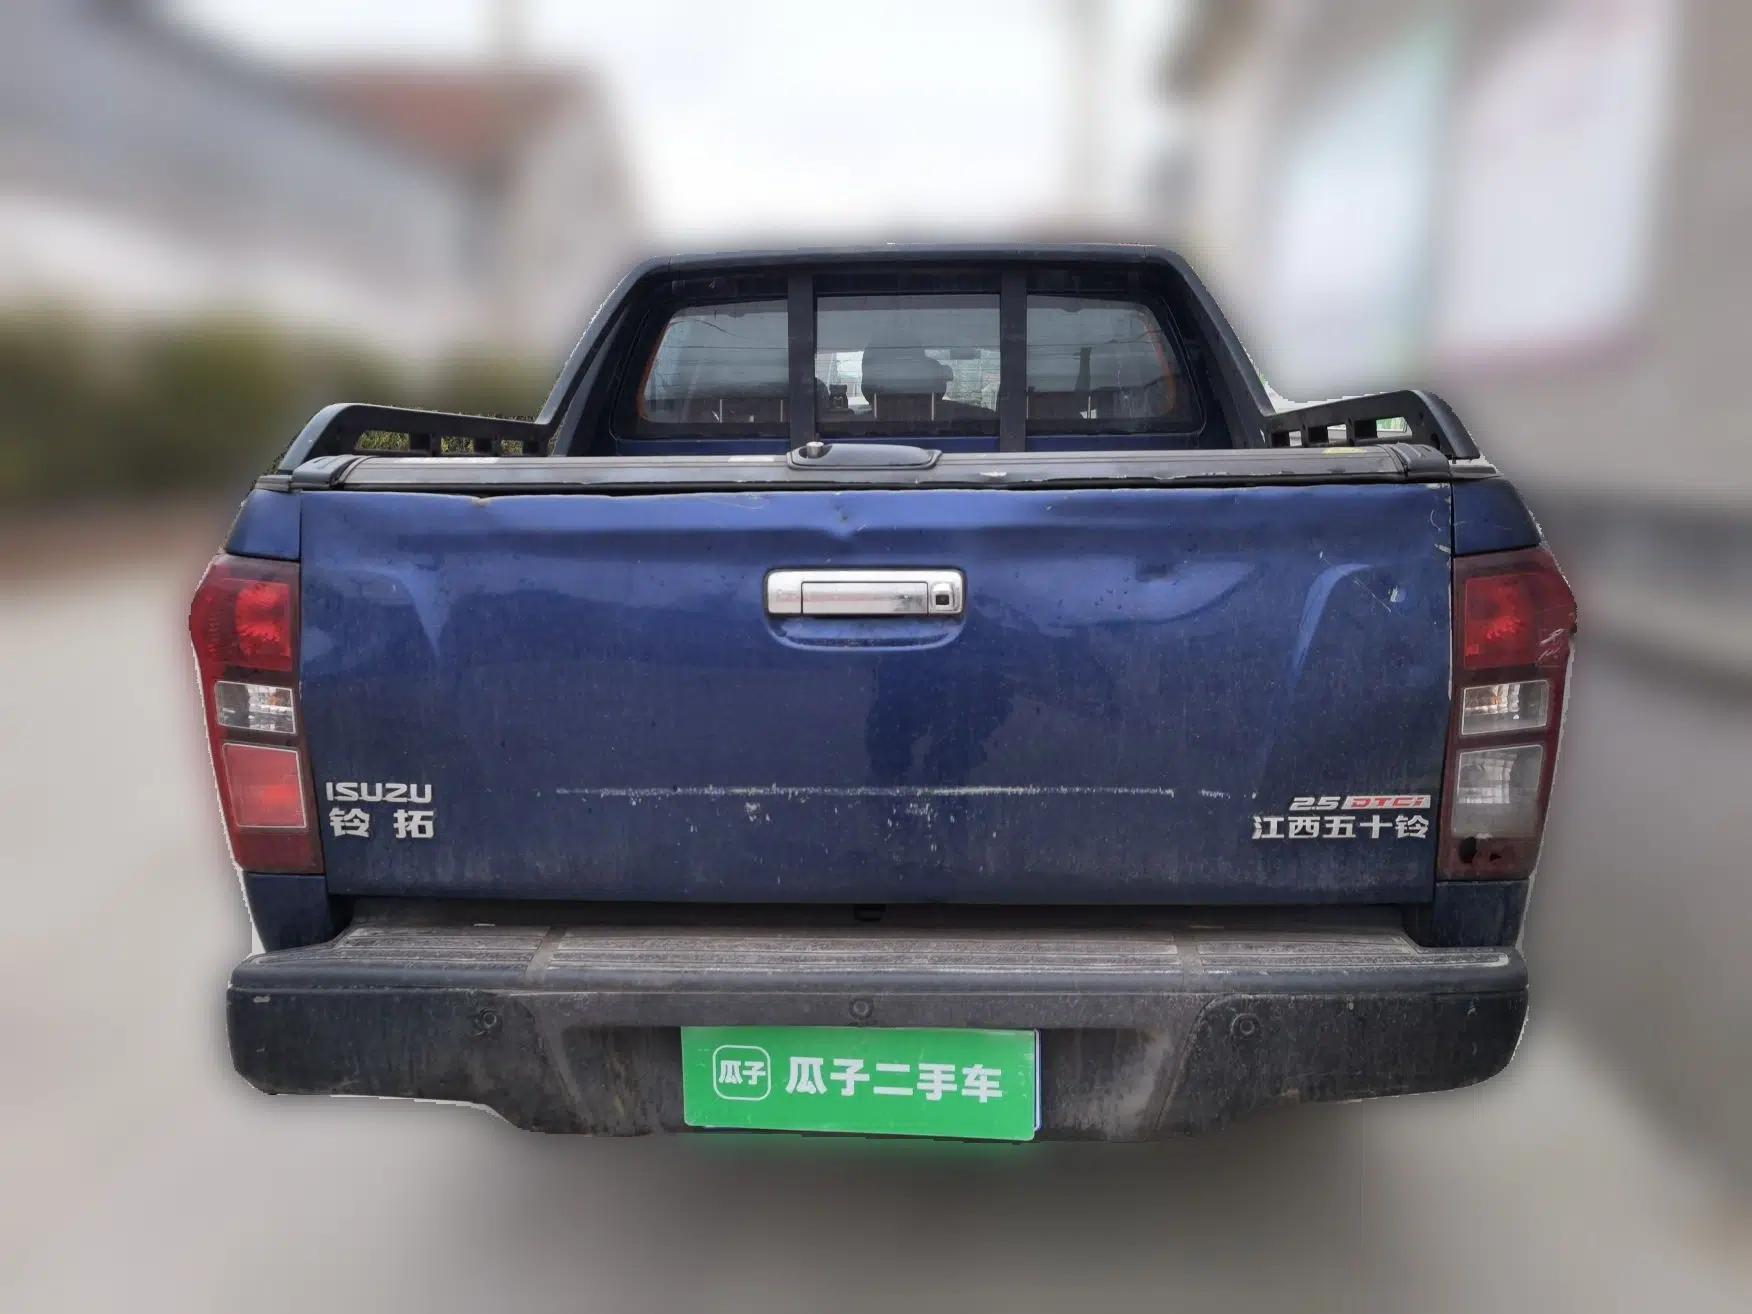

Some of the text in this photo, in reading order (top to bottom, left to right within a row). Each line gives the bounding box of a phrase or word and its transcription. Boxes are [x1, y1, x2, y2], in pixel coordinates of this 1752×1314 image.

[326, 782, 432, 803] ISUZU
[1252, 815, 1429, 839] 江西五十铃
[718, 1060, 766, 1085] 瓜子
[785, 1056, 1003, 1103] 瓜子二手车
